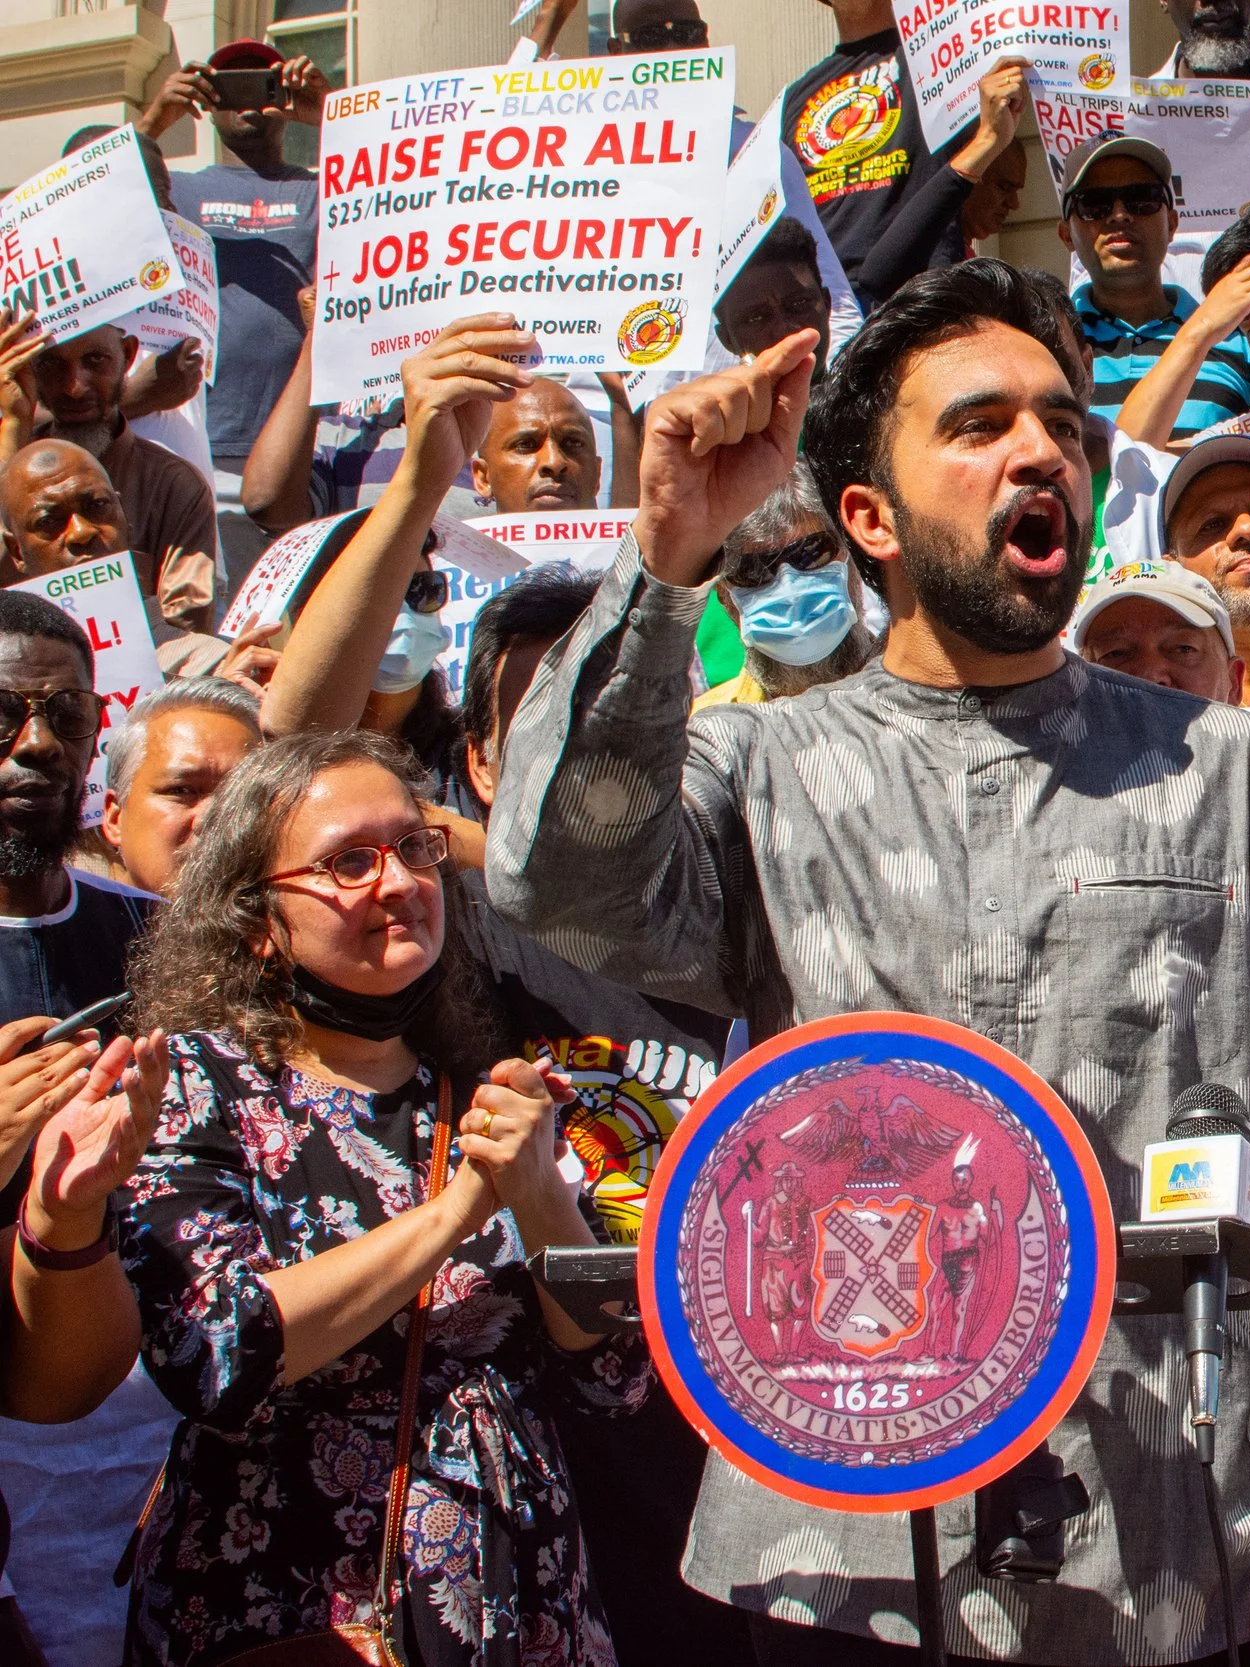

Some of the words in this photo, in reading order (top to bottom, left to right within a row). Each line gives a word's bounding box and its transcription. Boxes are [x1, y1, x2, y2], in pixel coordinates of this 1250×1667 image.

[908, 10, 960, 56] $25/Hour
[930, 33, 965, 78] JOB
[970, 5, 1119, 45] SECURITY!
[326, 90, 381, 122] UBER
[404, 77, 465, 105] LYFT
[492, 67, 605, 96] YELLOW
[631, 57, 724, 86] GREEN
[922, 81, 944, 106] Stop
[945, 51, 979, 84] Unfair
[983, 29, 1112, 57] Deactivations!
[390, 100, 476, 131] LIVERY
[502, 92, 594, 118] BLACK
[602, 87, 659, 113] CAR
[946, 91, 967, 112] DRIVER
[1055, 93, 1078, 106] ALL
[1080, 97, 1124, 112] TRIPS!
[1128, 103, 1154, 117] ALL
[1158, 104, 1229, 118] DRIVERS!
[14, 165, 69, 204] YELLOW
[81, 130, 132, 164] GREEN
[323, 133, 445, 199] RAISE
[458, 125, 567, 173] FOR
[584, 119, 697, 167] ALL!
[20, 201, 45, 224] ALL
[46, 163, 111, 206] DRIVERS!
[327, 188, 437, 230] $25/Hour
[445, 174, 620, 203] Take-Home
[1179, 208, 1236, 219] ALLIANCE
[3, 236, 64, 295] ALL!
[352, 231, 429, 285] JOB
[445, 216, 702, 266] SECURITY!
[720, 218, 758, 269] ALLIANCE
[82, 276, 138, 309] ALLIANCE
[323, 296, 371, 324] Stop
[378, 272, 452, 312] Unfair
[460, 265, 683, 296] Deactivations!
[371, 334, 410, 357] DRIVER
[532, 318, 602, 336] POWER!
[363, 377, 381, 389] NEW
[529, 354, 605, 365] NYTWA.ORG
[478, 524, 525, 542] THE
[46, 561, 125, 598] GREEN
[281, 580, 296, 598] NEW
[751, 1374, 911, 1444] CIVITATIS
[918, 1367, 995, 1434] NOVI
[997, 1222, 1047, 1369] EBORACI
[832, 1382, 910, 1411] 1625
